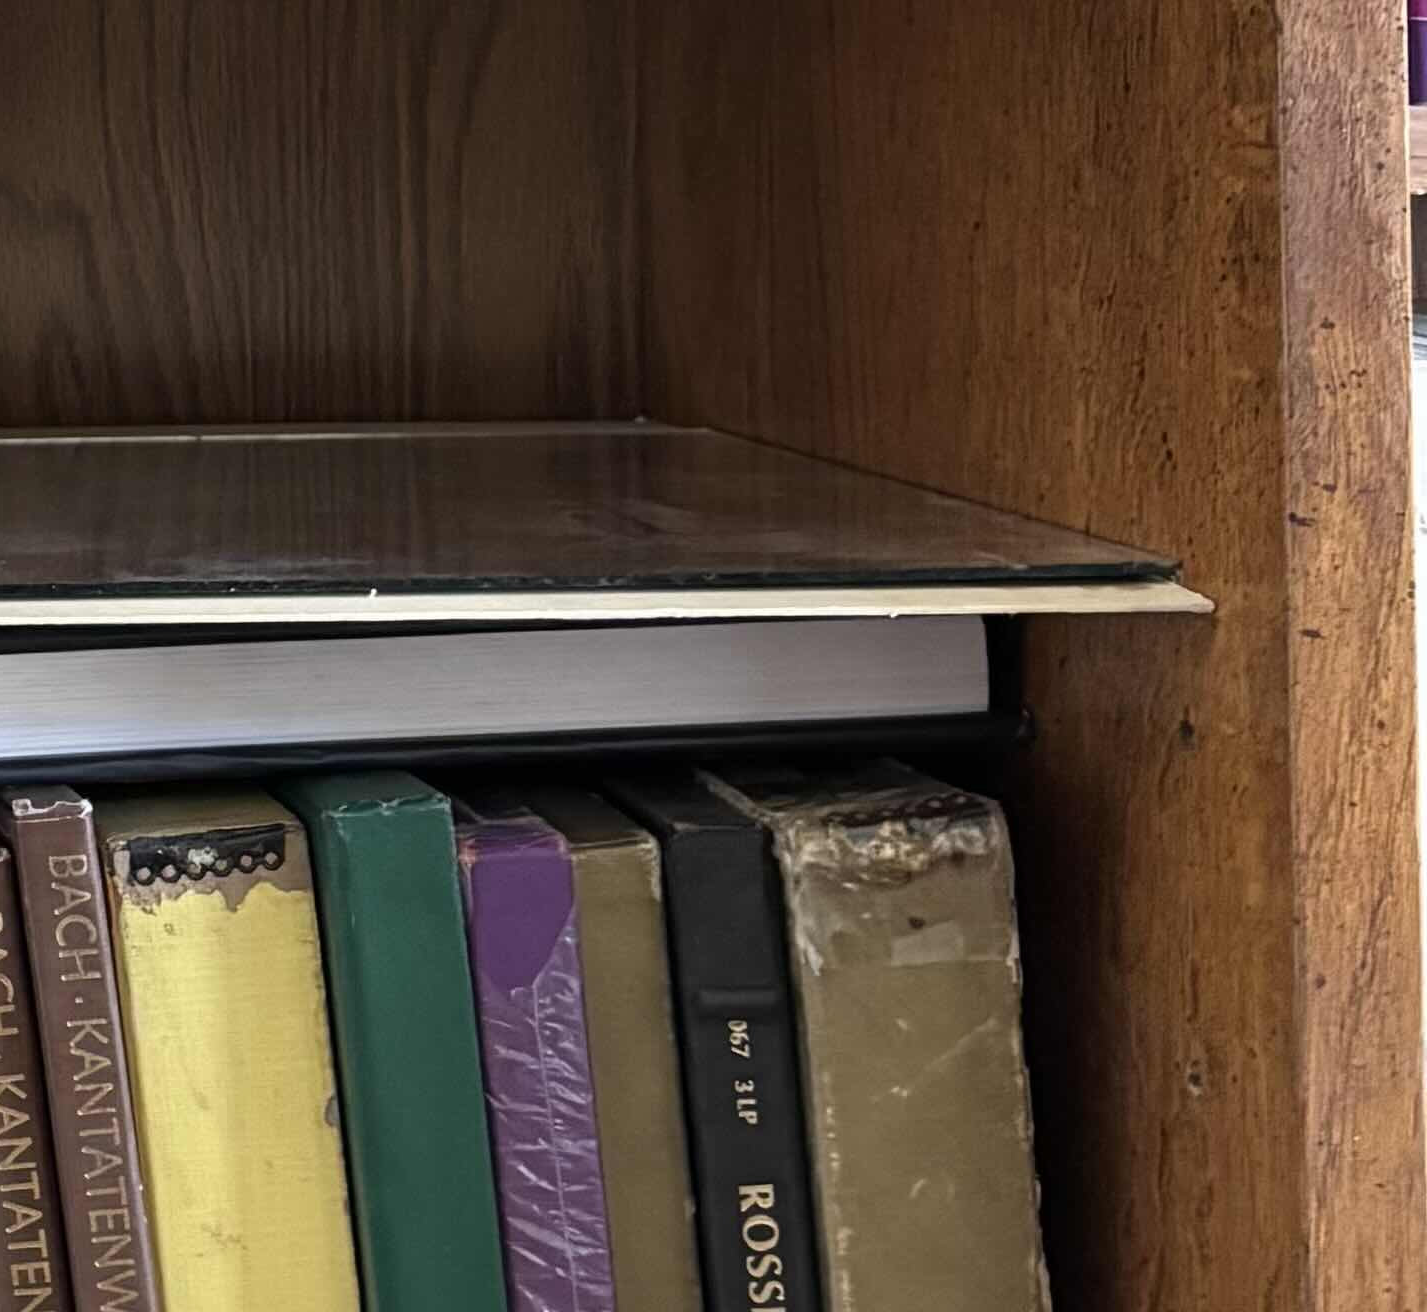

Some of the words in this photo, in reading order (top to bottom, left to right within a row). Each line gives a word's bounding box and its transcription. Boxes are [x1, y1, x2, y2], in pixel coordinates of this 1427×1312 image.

[48, 854, 101, 982] BACH
[734, 1079, 755, 1093] 3
[737, 1098, 758, 1125] LP
